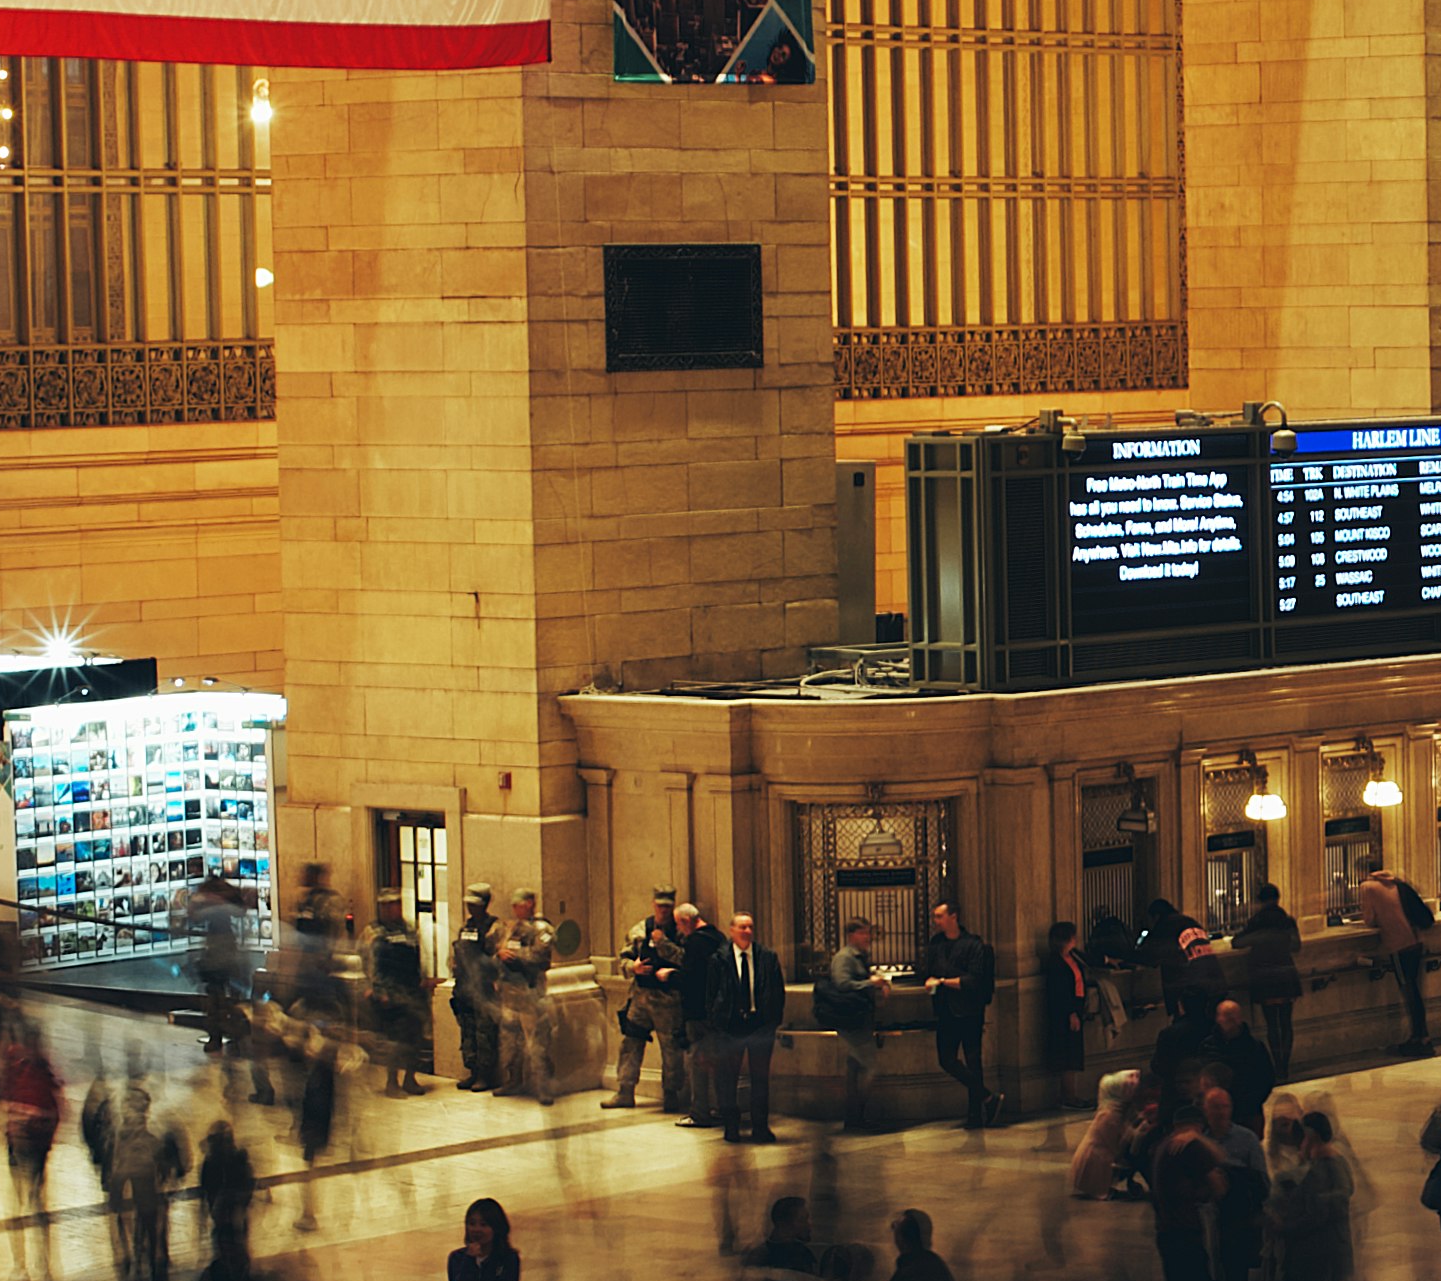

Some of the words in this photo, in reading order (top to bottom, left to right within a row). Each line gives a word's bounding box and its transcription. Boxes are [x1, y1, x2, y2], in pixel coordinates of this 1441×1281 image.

[1353, 430, 1407, 449] HARLEM
[1409, 428, 1440, 446] LINE
[1113, 439, 1200, 459] INFORMATION
[1270, 468, 1293, 483] TIME
[1303, 467, 1323, 480] TRK
[1333, 463, 1397, 479] DESTINATION
[1344, 485, 1369, 498] WHITE
[1371, 484, 1399, 497] PLAINS
[1310, 510, 1324, 522] 112
[1335, 506, 1382, 521] SOUTHEAST
[1335, 528, 1366, 542] MOUNT
[1363, 526, 1390, 539] KISCO
[1335, 548, 1387, 563] CRESTWOOD
[1336, 591, 1384, 607] SOUTHEAST
